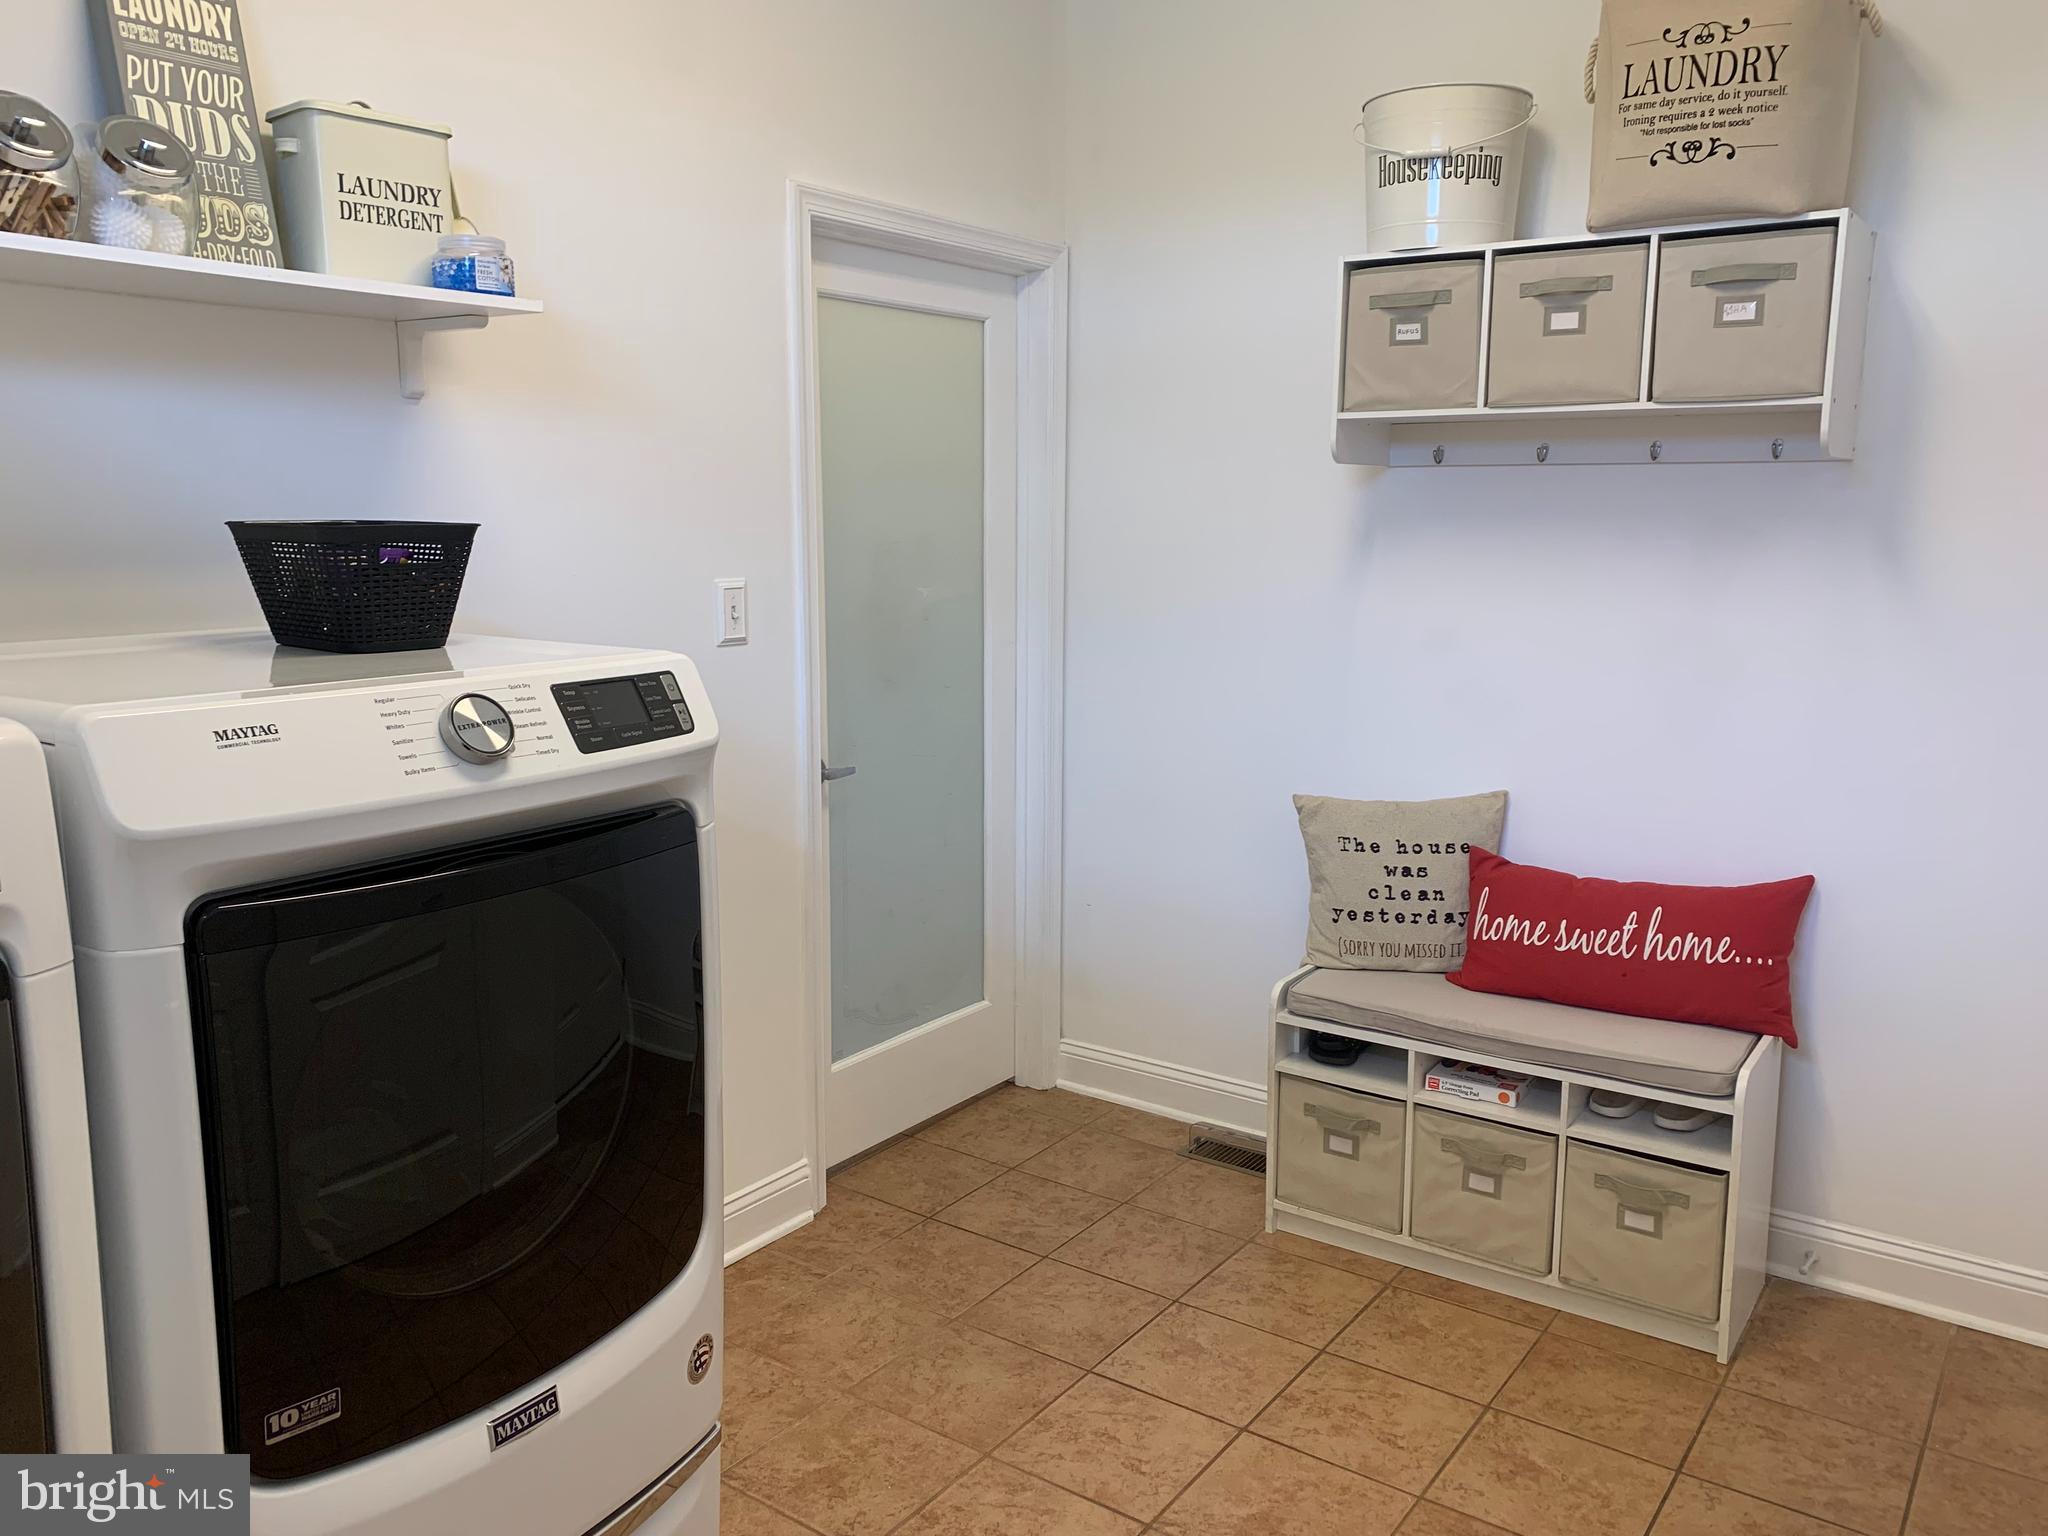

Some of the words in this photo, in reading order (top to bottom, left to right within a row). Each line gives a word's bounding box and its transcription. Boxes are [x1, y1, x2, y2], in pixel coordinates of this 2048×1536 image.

[118, 20, 160, 44] OPEN
[164, 31, 186, 51] 24
[188, 36, 239, 63] HOURS
[126, 54, 175, 98] PUT
[180, 66, 247, 112] YOUR
[1622, 44, 1790, 100] LAUNDRY
[1618, 103, 1631, 114] For
[1633, 101, 1657, 111] same
[1659, 97, 1676, 110] day
[1678, 94, 1715, 106] service,
[1718, 90, 1731, 100] do
[1733, 88, 1741, 99] it
[1623, 115, 1657, 128] Ironing
[1658, 110, 1698, 126] requires
[1699, 111, 1706, 119] a
[1707, 108, 1716, 117] 2
[1718, 103, 1743, 115] week
[1746, 103, 1779, 113] notice
[1656, 122, 1698, 136] responsible
[1700, 120, 1711, 130] for
[1712, 119, 1727, 128] lost
[195, 160, 246, 197] THE
[1378, 145, 1503, 188] Housekeeping
[337, 172, 442, 207] LAUNDRY
[339, 200, 444, 233] DETERGENT
[373, 697, 396, 705] Regular
[212, 723, 279, 742] MAYTAG
[457, 721, 482, 731] EXTRA
[482, 717, 507, 726] POWER
[217, 741, 250, 750] COMMERCIAL
[251, 737, 281, 745] TECHNOLOGY
[1338, 836, 1381, 853] The
[1395, 839, 1471, 854] house
[1384, 865, 1428, 878] was
[1368, 885, 1445, 901] clean
[1332, 907, 1470, 928] yesterday
[1473, 886, 1550, 946] home
[1554, 910, 1638, 960] sweet
[1378, 942, 1400, 958] YOU
[1405, 943, 1446, 959] MISSED
[1469, 1089, 1480, 1097] Pad
[269, 1408, 299, 1434] 10
[301, 1392, 337, 1411] YEAR
[495, 1397, 557, 1442] MAYTAG
